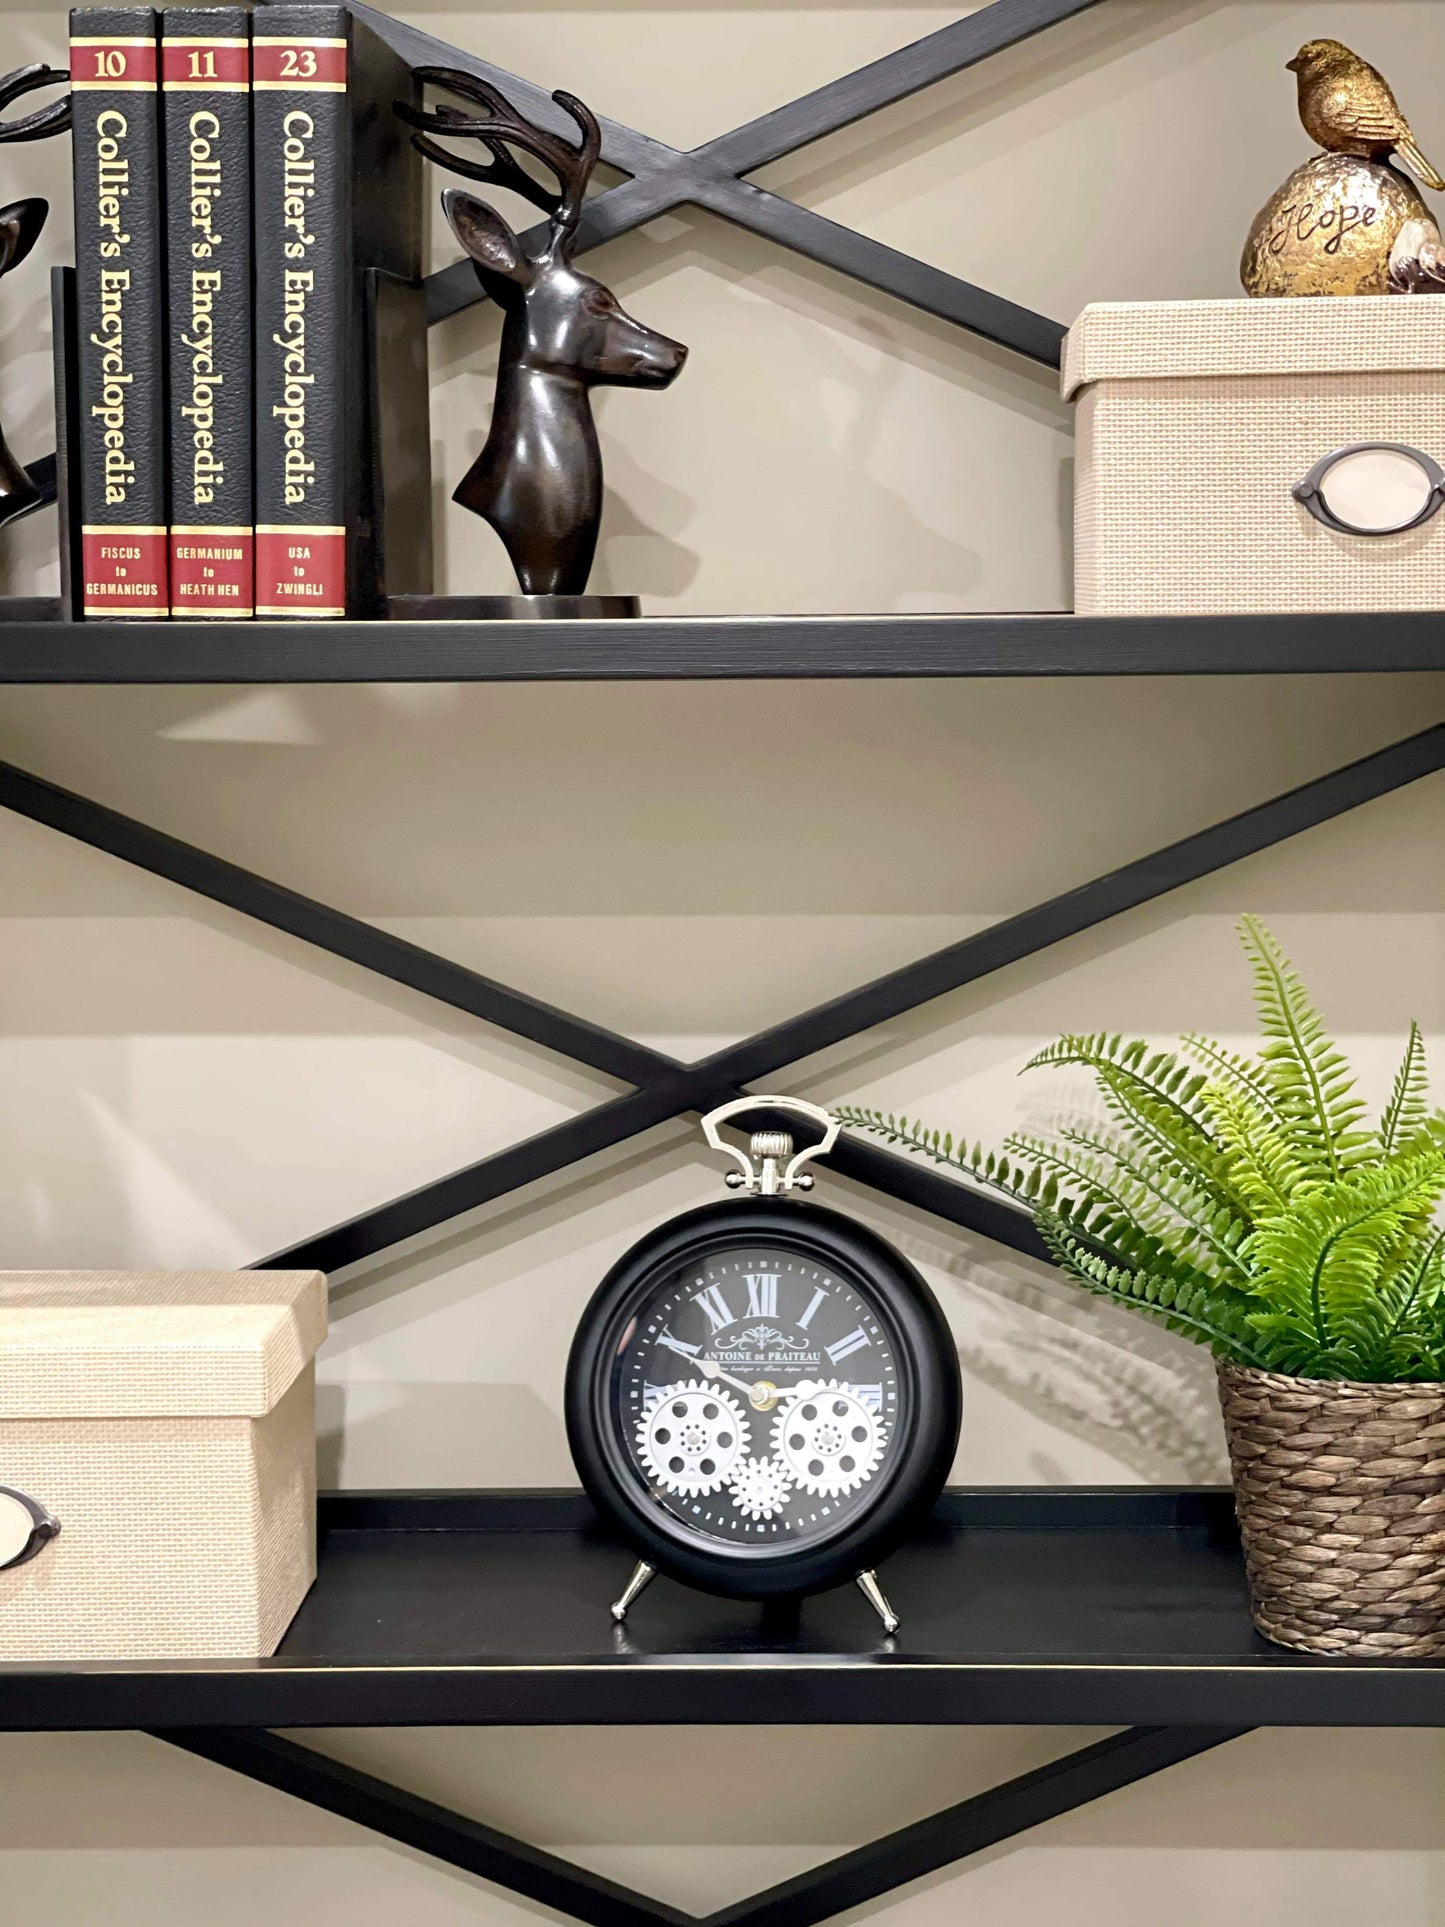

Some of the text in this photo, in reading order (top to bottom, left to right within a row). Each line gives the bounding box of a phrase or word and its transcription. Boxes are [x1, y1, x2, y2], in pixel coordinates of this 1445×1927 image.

[93, 50, 127, 78] 10
[187, 50, 218, 78] 11
[279, 49, 318, 78] 23
[1267, 202, 1377, 256] Hope
[90, 109, 136, 505] Collier's Encyclopedia
[180, 110, 224, 505] Collier's Encyclopedia
[272, 110, 316, 505] Collier's Encyclopedia
[101, 547, 141, 559] FISCUS
[176, 546, 243, 560] GERMANIUM
[288, 546, 311, 559] USA
[115, 566, 127, 578] to
[202, 566, 215, 578] to
[293, 565, 305, 577] to
[86, 583, 158, 596] GERMANICUS
[180, 583, 240, 596] HEATH HEN
[276, 582, 324, 596] ZWINGLI
[742, 1273, 782, 1319] XII
[689, 1282, 738, 1336] XI
[824, 1324, 871, 1366] II
[703, 1351, 752, 1361] ANTOINE
[767, 1351, 821, 1361] PRAITEAU
